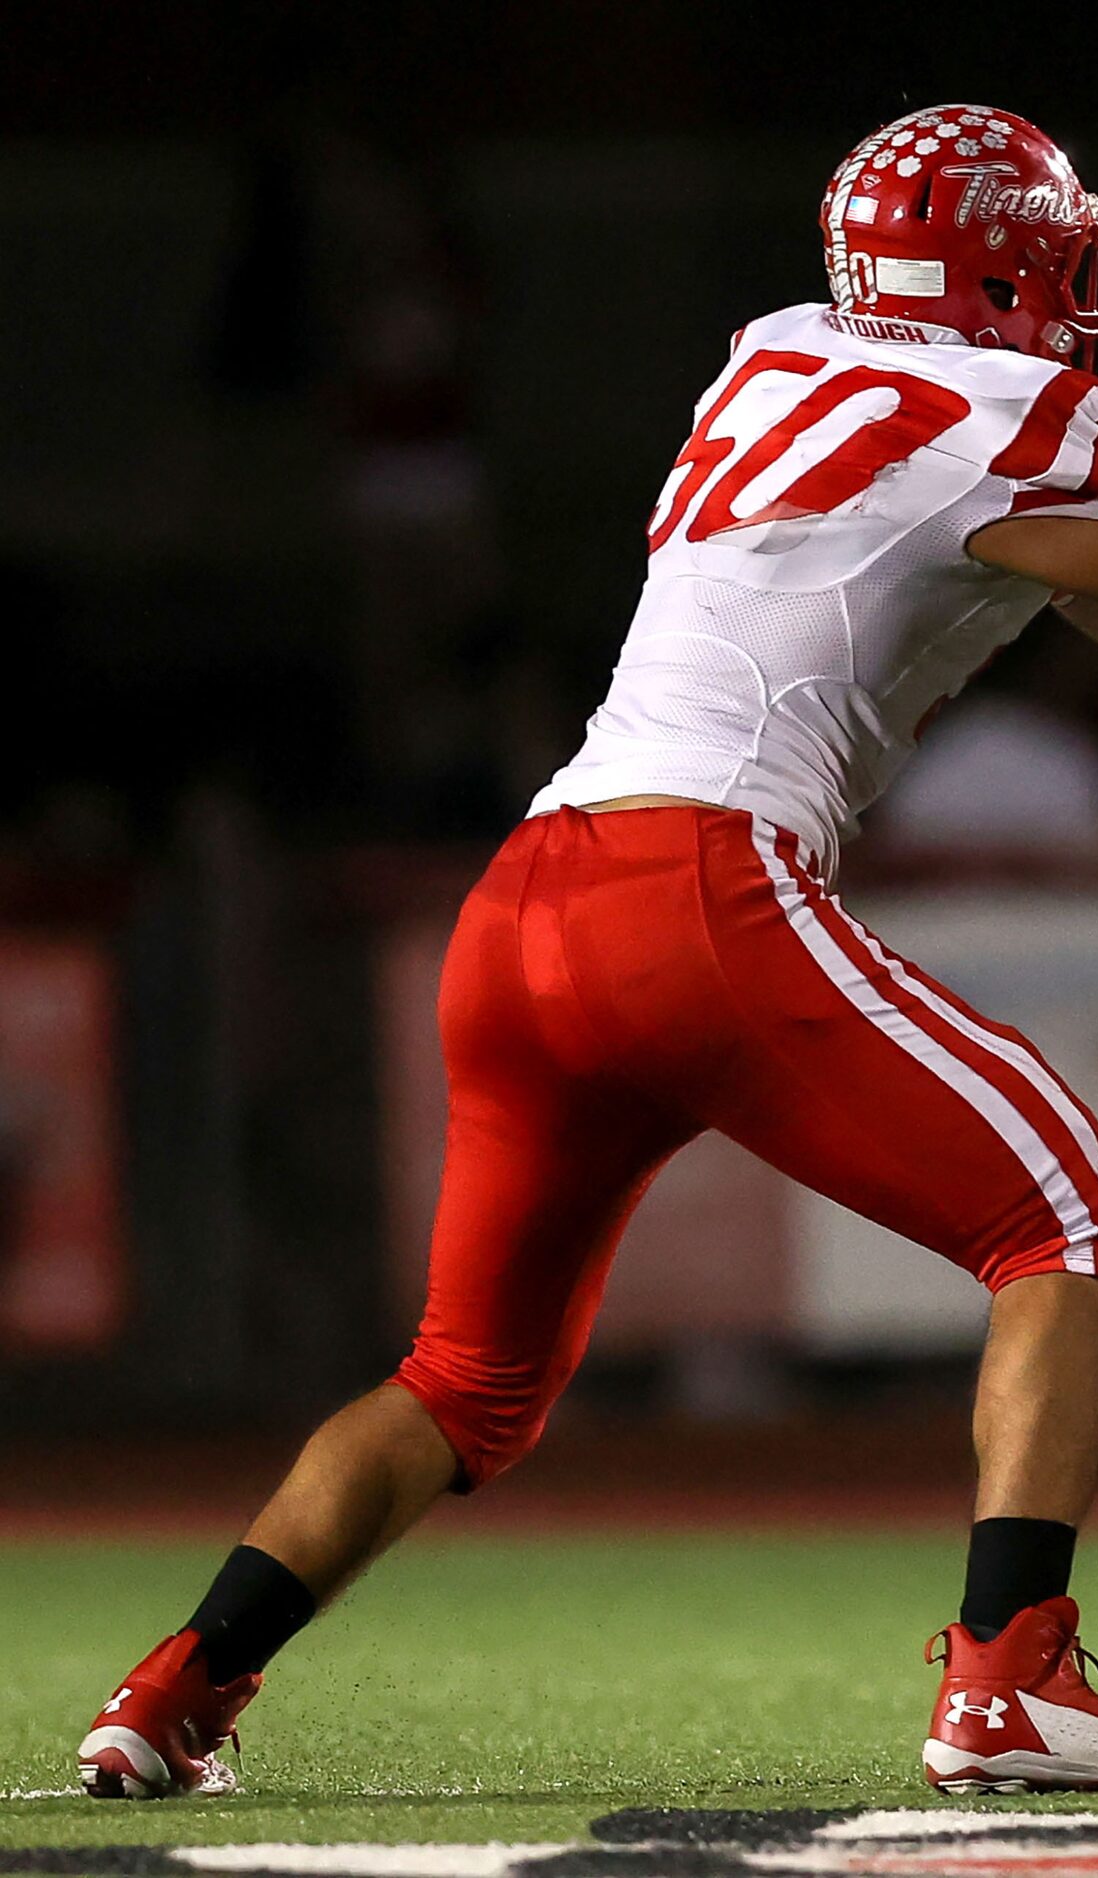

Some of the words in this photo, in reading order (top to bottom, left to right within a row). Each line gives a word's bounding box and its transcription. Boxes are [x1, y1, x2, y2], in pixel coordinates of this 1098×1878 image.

[940, 160, 1080, 250] Tigers
[840, 316, 929, 345] TOUGH
[647, 349, 972, 554] 50
